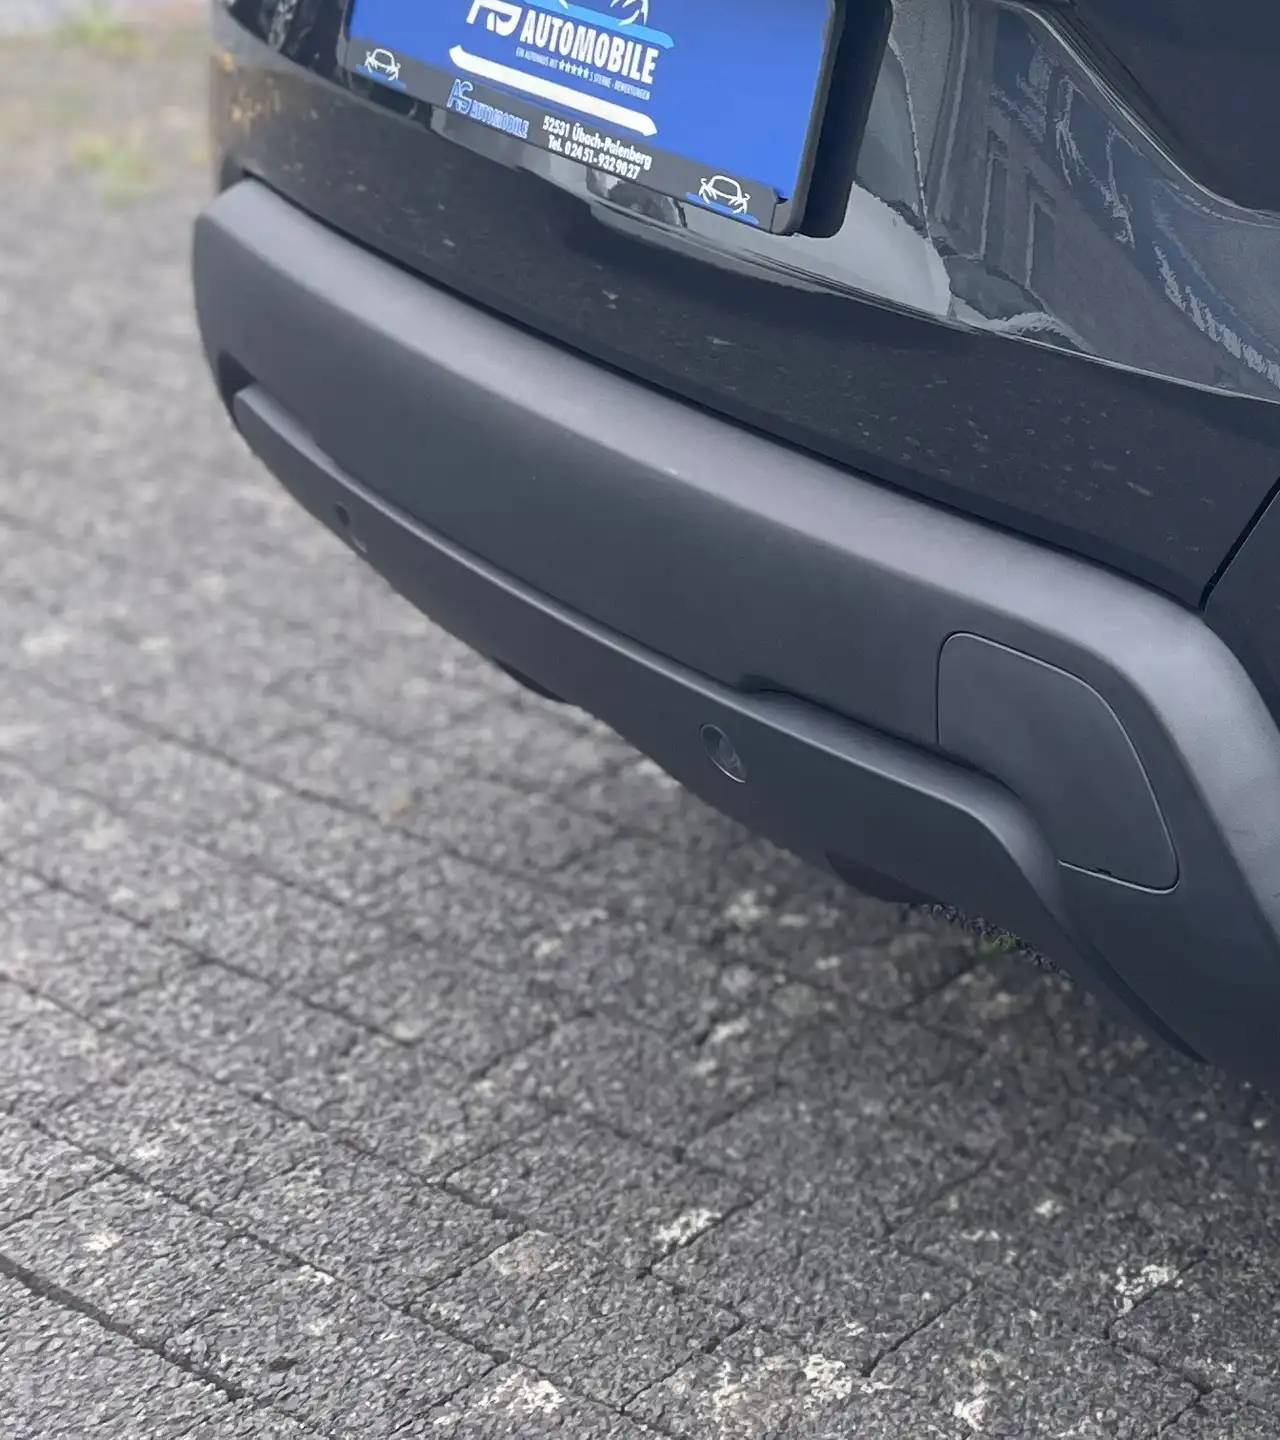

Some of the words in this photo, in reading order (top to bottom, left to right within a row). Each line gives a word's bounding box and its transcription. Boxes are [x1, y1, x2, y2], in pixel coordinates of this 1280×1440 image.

[519, 8, 660, 85] AUTOMOBILE
[447, 79, 474, 114] AS
[470, 101, 529, 138] AUTOMOBILE
[542, 115, 571, 138] 52531
[571, 121, 653, 171] Übach-Palenberg
[547, 133, 564, 152] Tel.
